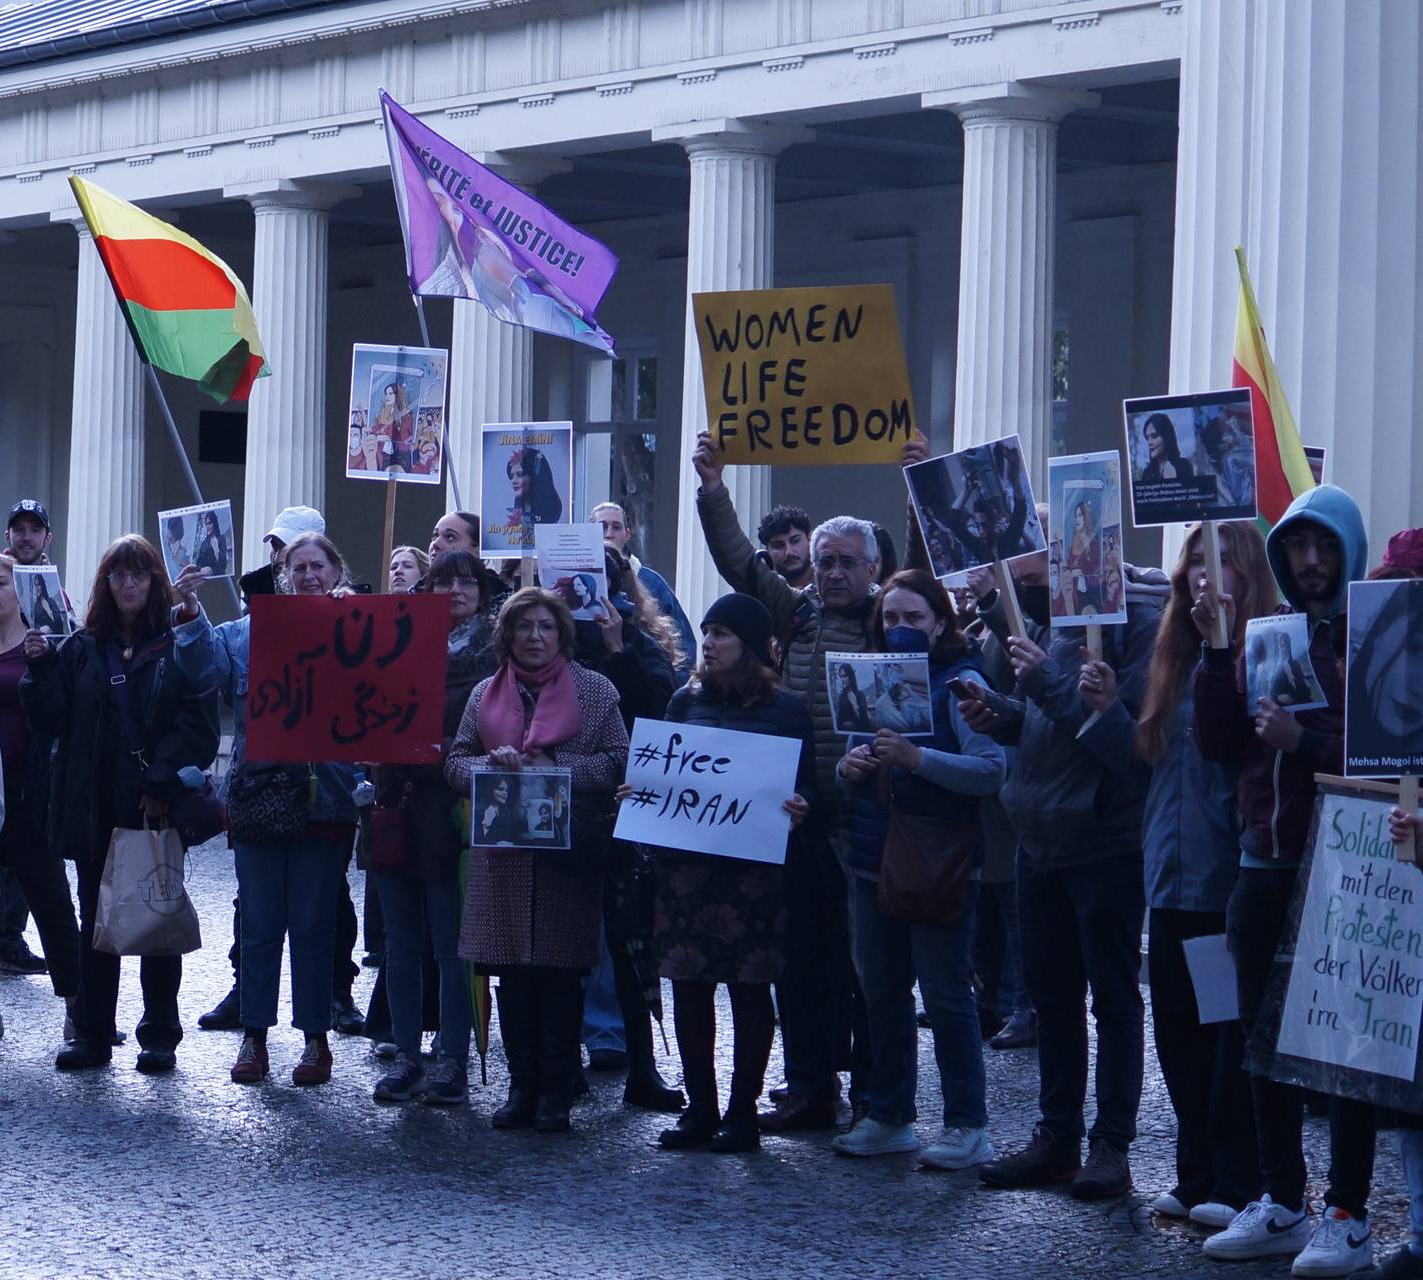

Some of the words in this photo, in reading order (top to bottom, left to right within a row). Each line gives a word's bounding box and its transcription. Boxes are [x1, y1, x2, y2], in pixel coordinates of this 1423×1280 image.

[469, 193, 494, 216] et
[491, 206, 586, 278] JUSTICE!
[705, 304, 863, 352] WOMEN
[721, 358, 807, 406] LIFE
[717, 398, 911, 453] FREEDOM
[334, 601, 413, 668] زن
[250, 644, 328, 731] آزادی
[331, 679, 419, 744] زندگی
[633, 732, 732, 775] #free
[1349, 757, 1379, 766] Mehsa
[630, 786, 753, 827] #IRAN
[1340, 862, 1373, 896] mit
[1375, 867, 1414, 904] den
[1323, 895, 1423, 958] Protesten
[1314, 944, 1352, 980] der
[1307, 989, 1340, 1031] im
